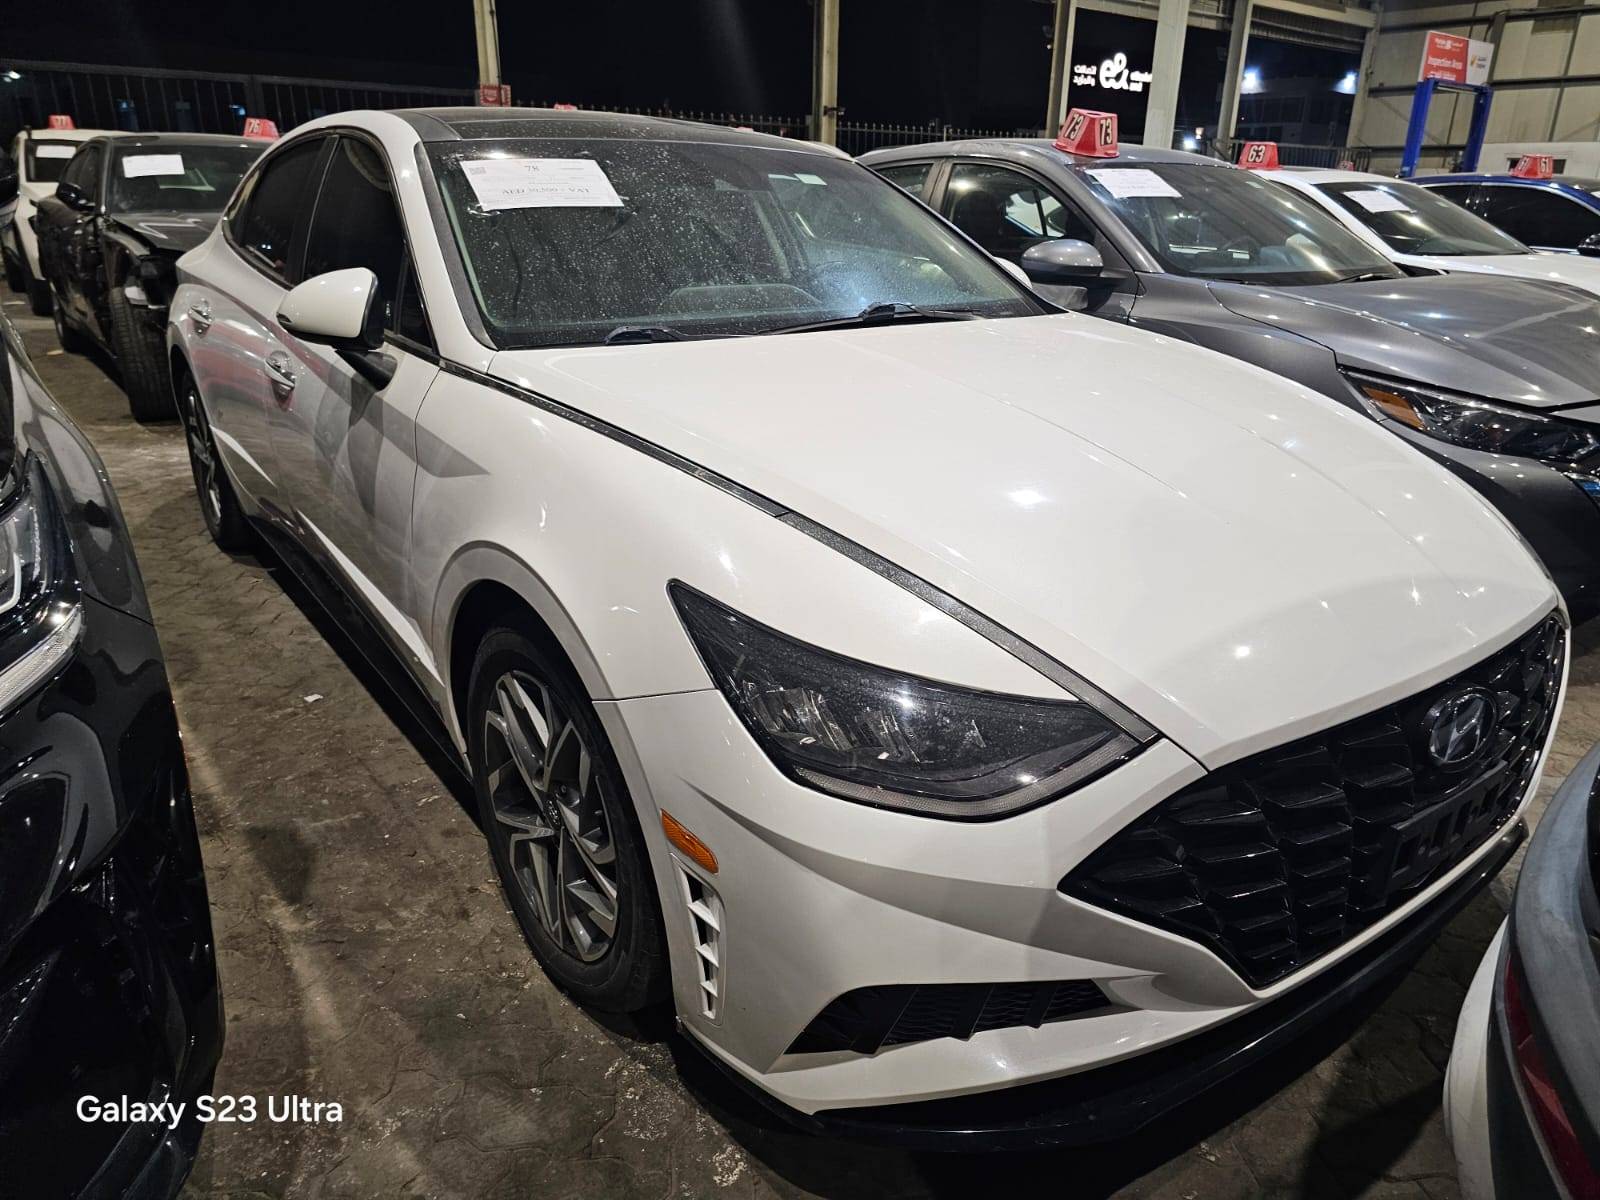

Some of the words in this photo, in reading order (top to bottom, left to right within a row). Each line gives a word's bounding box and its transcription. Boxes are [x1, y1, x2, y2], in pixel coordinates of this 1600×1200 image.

[1065, 113, 1084, 141] 73
[1100, 118, 1113, 146] 73
[1248, 145, 1266, 163] 63
